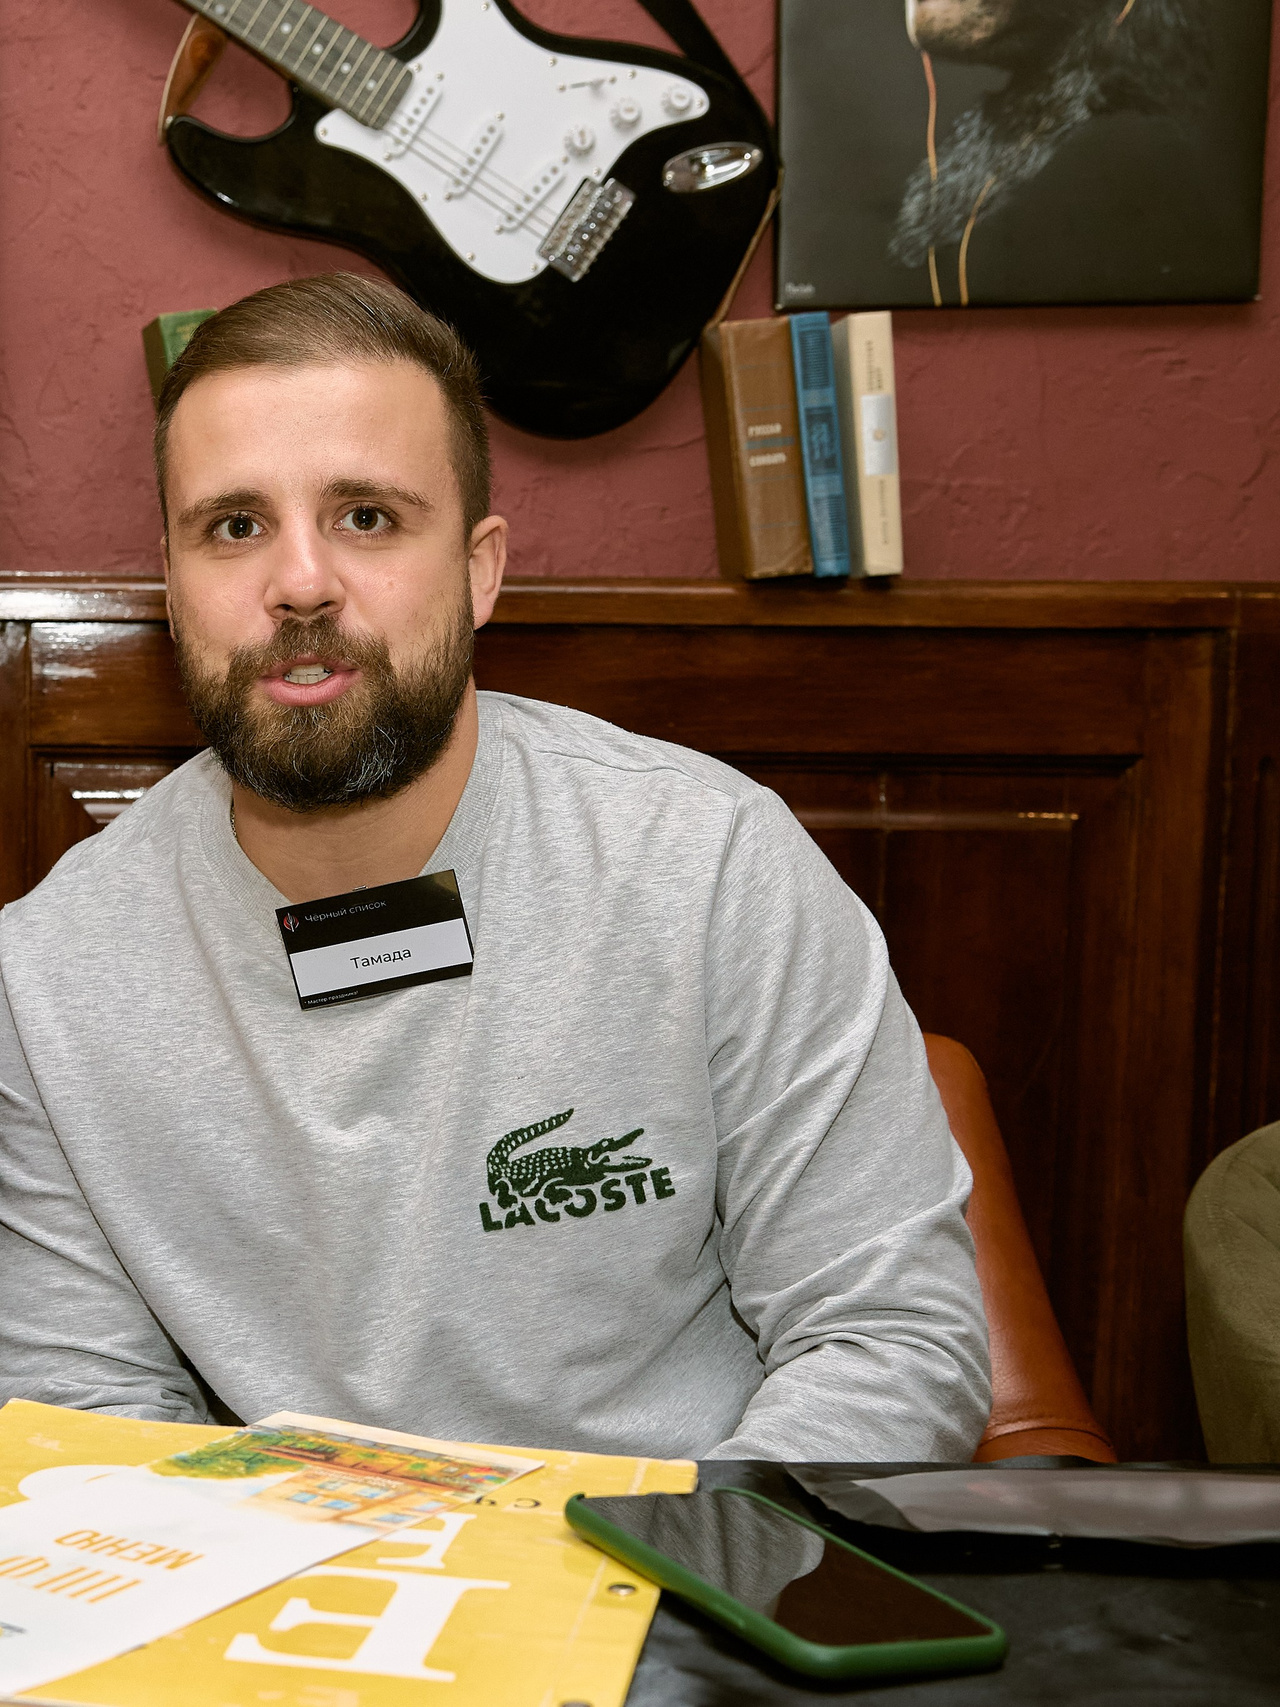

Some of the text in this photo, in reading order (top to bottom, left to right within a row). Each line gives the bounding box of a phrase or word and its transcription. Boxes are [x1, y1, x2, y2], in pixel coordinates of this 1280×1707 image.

[305, 901, 387, 922] Чёрный список
[350, 949, 412, 969] Тамада
[479, 1166, 676, 1232] LACOSTE
[54, 1530, 205, 1570] МЕНЮ
